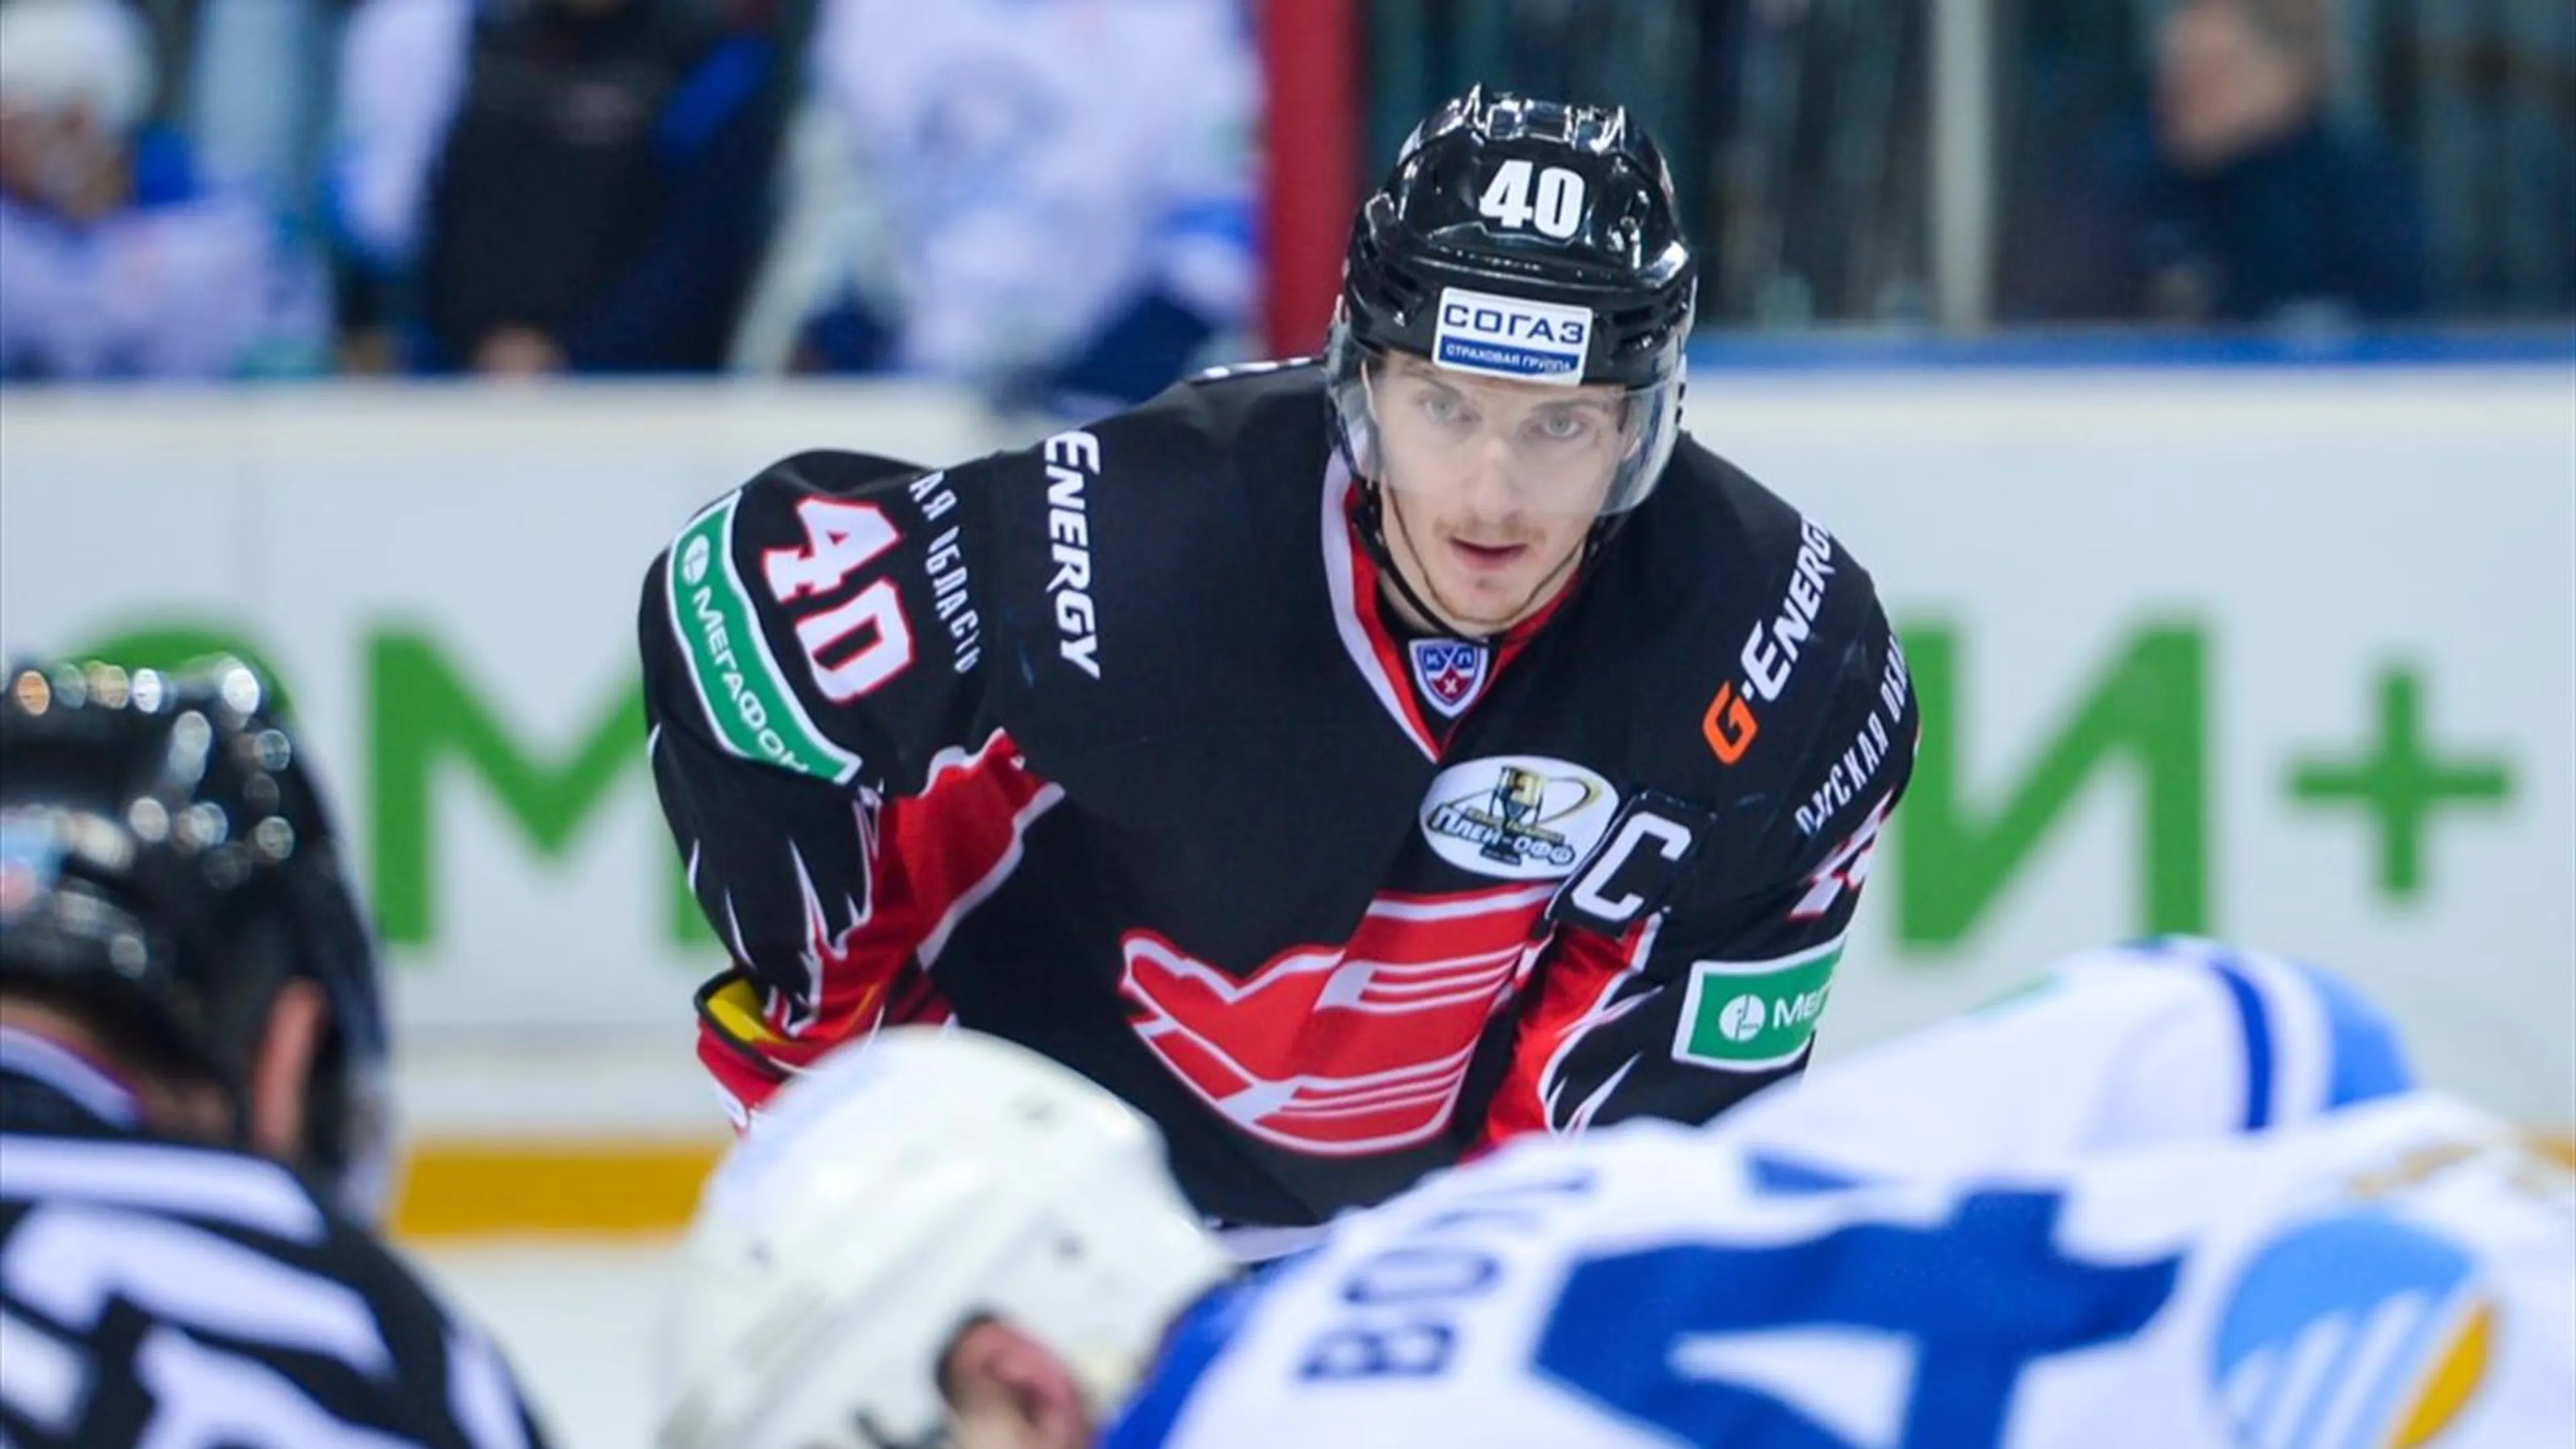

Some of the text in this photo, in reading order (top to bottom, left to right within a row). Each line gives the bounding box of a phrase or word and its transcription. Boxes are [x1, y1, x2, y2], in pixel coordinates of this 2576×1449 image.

[1479, 159, 1585, 239] 40
[1444, 304, 1585, 345] СОГАЗ
[1446, 343, 1572, 374] СТРАХОВАЯ ГРУППА
[1044, 429, 1101, 680] ENERGY
[761, 495, 915, 706] 40
